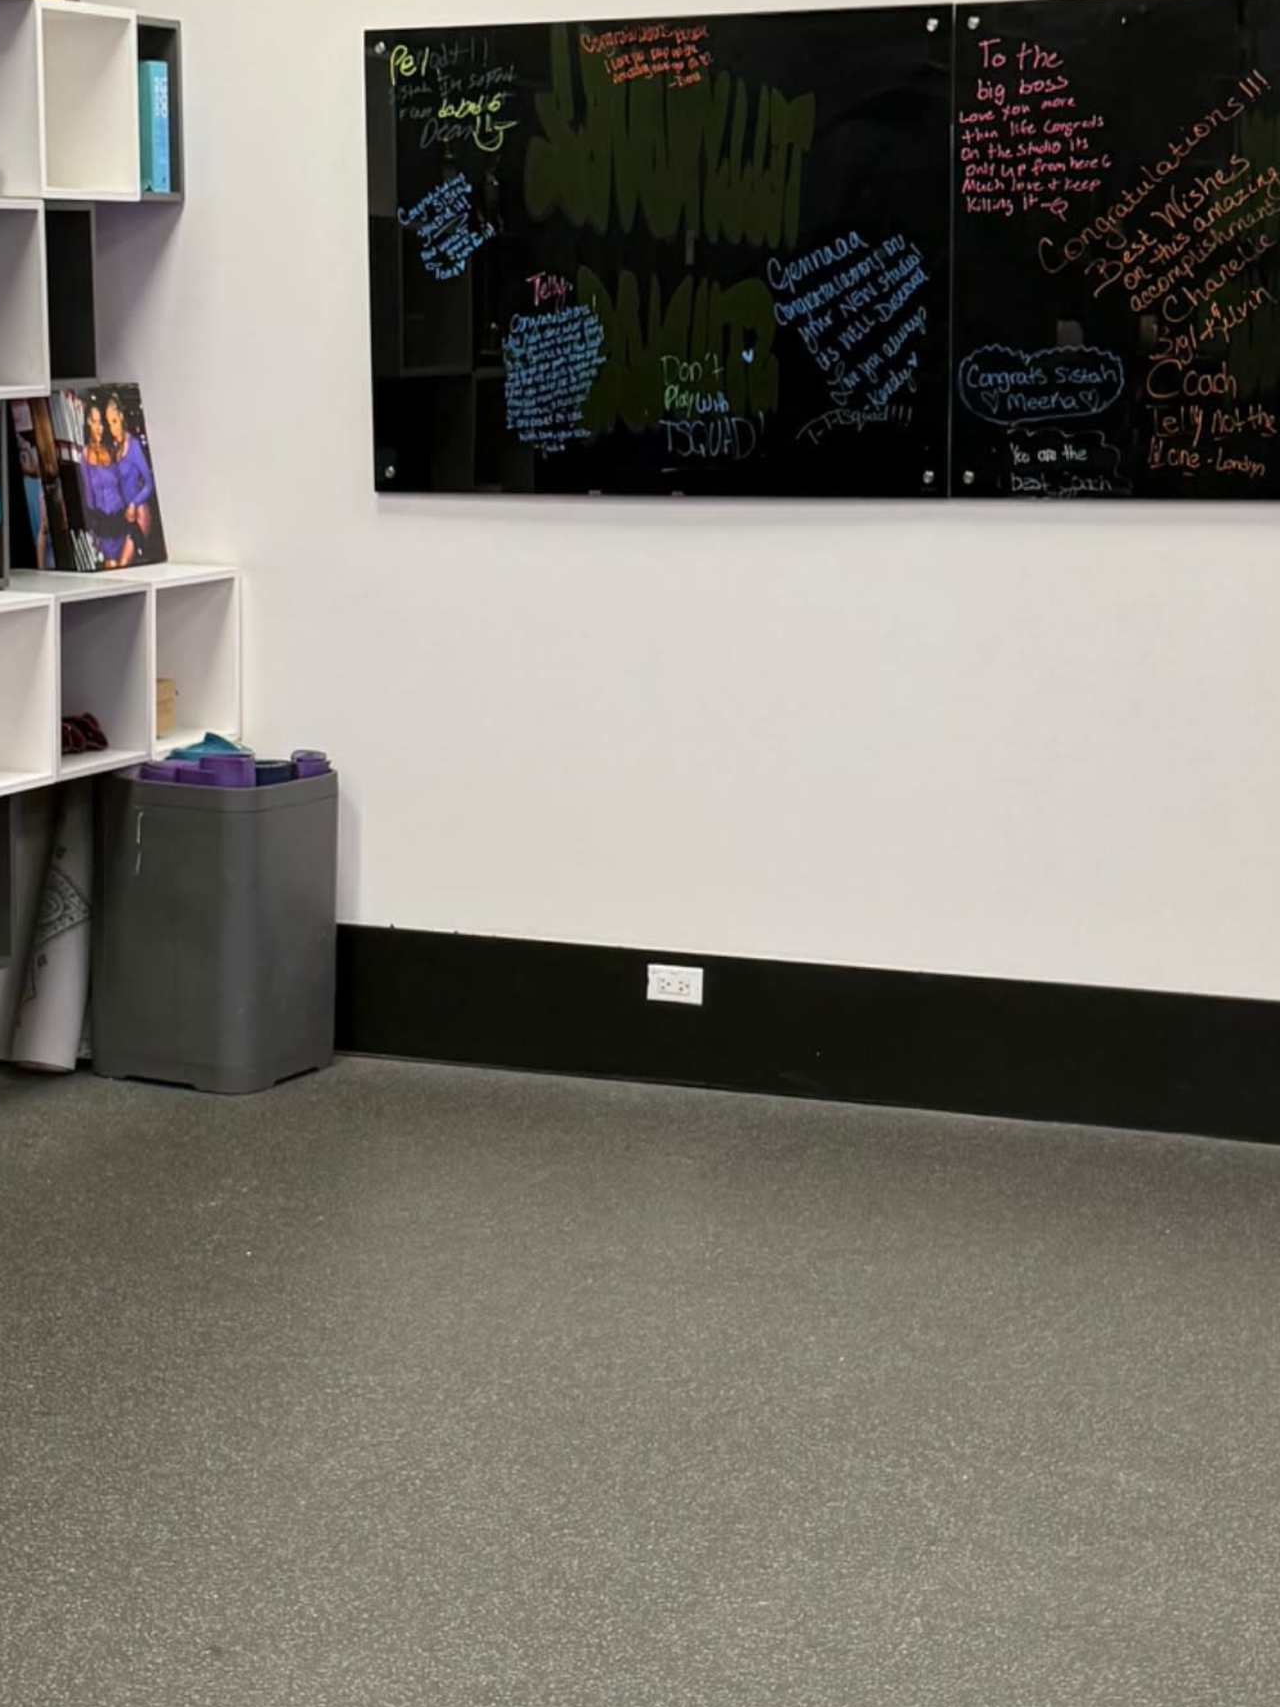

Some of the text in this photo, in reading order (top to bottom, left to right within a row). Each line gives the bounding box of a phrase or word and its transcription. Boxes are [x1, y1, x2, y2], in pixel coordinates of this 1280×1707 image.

[978, 38, 1065, 70] To the
[977, 75, 1069, 106] big boss
[959, 97, 1076, 124] Love you more
[961, 128, 999, 144] than
[1010, 121, 1037, 137] life
[987, 144, 1013, 159] the
[1031, 158, 1066, 176] from
[1070, 155, 1099, 169] here
[962, 178, 1005, 194] Much
[1011, 177, 1044, 191] love
[1038, 69, 1272, 275] Congratulations!!!
[1084, 153, 1251, 298] Best Wishes
[1123, 265, 1152, 290] on
[1149, 232, 1191, 265] this
[660, 352, 724, 385] Don't
[966, 363, 1048, 393] Congrats
[664, 384, 694, 418] Play
